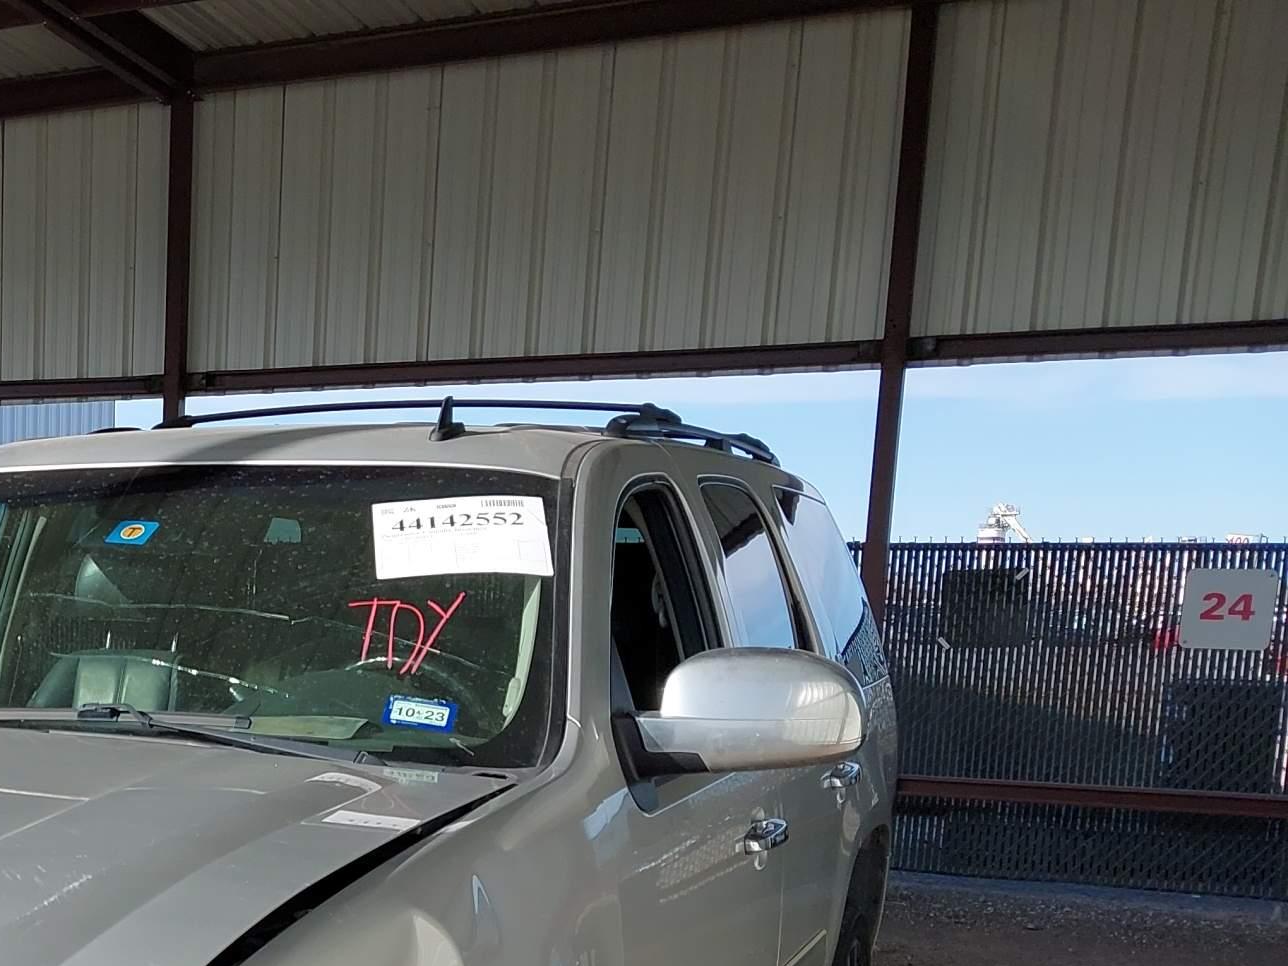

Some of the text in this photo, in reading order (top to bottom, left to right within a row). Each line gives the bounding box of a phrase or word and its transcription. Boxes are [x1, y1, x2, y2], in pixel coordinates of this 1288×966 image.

[391, 511, 524, 532] 44142552
[1199, 592, 1256, 622] 24
[347, 591, 466, 675] TDY
[423, 710, 446, 722] 23
